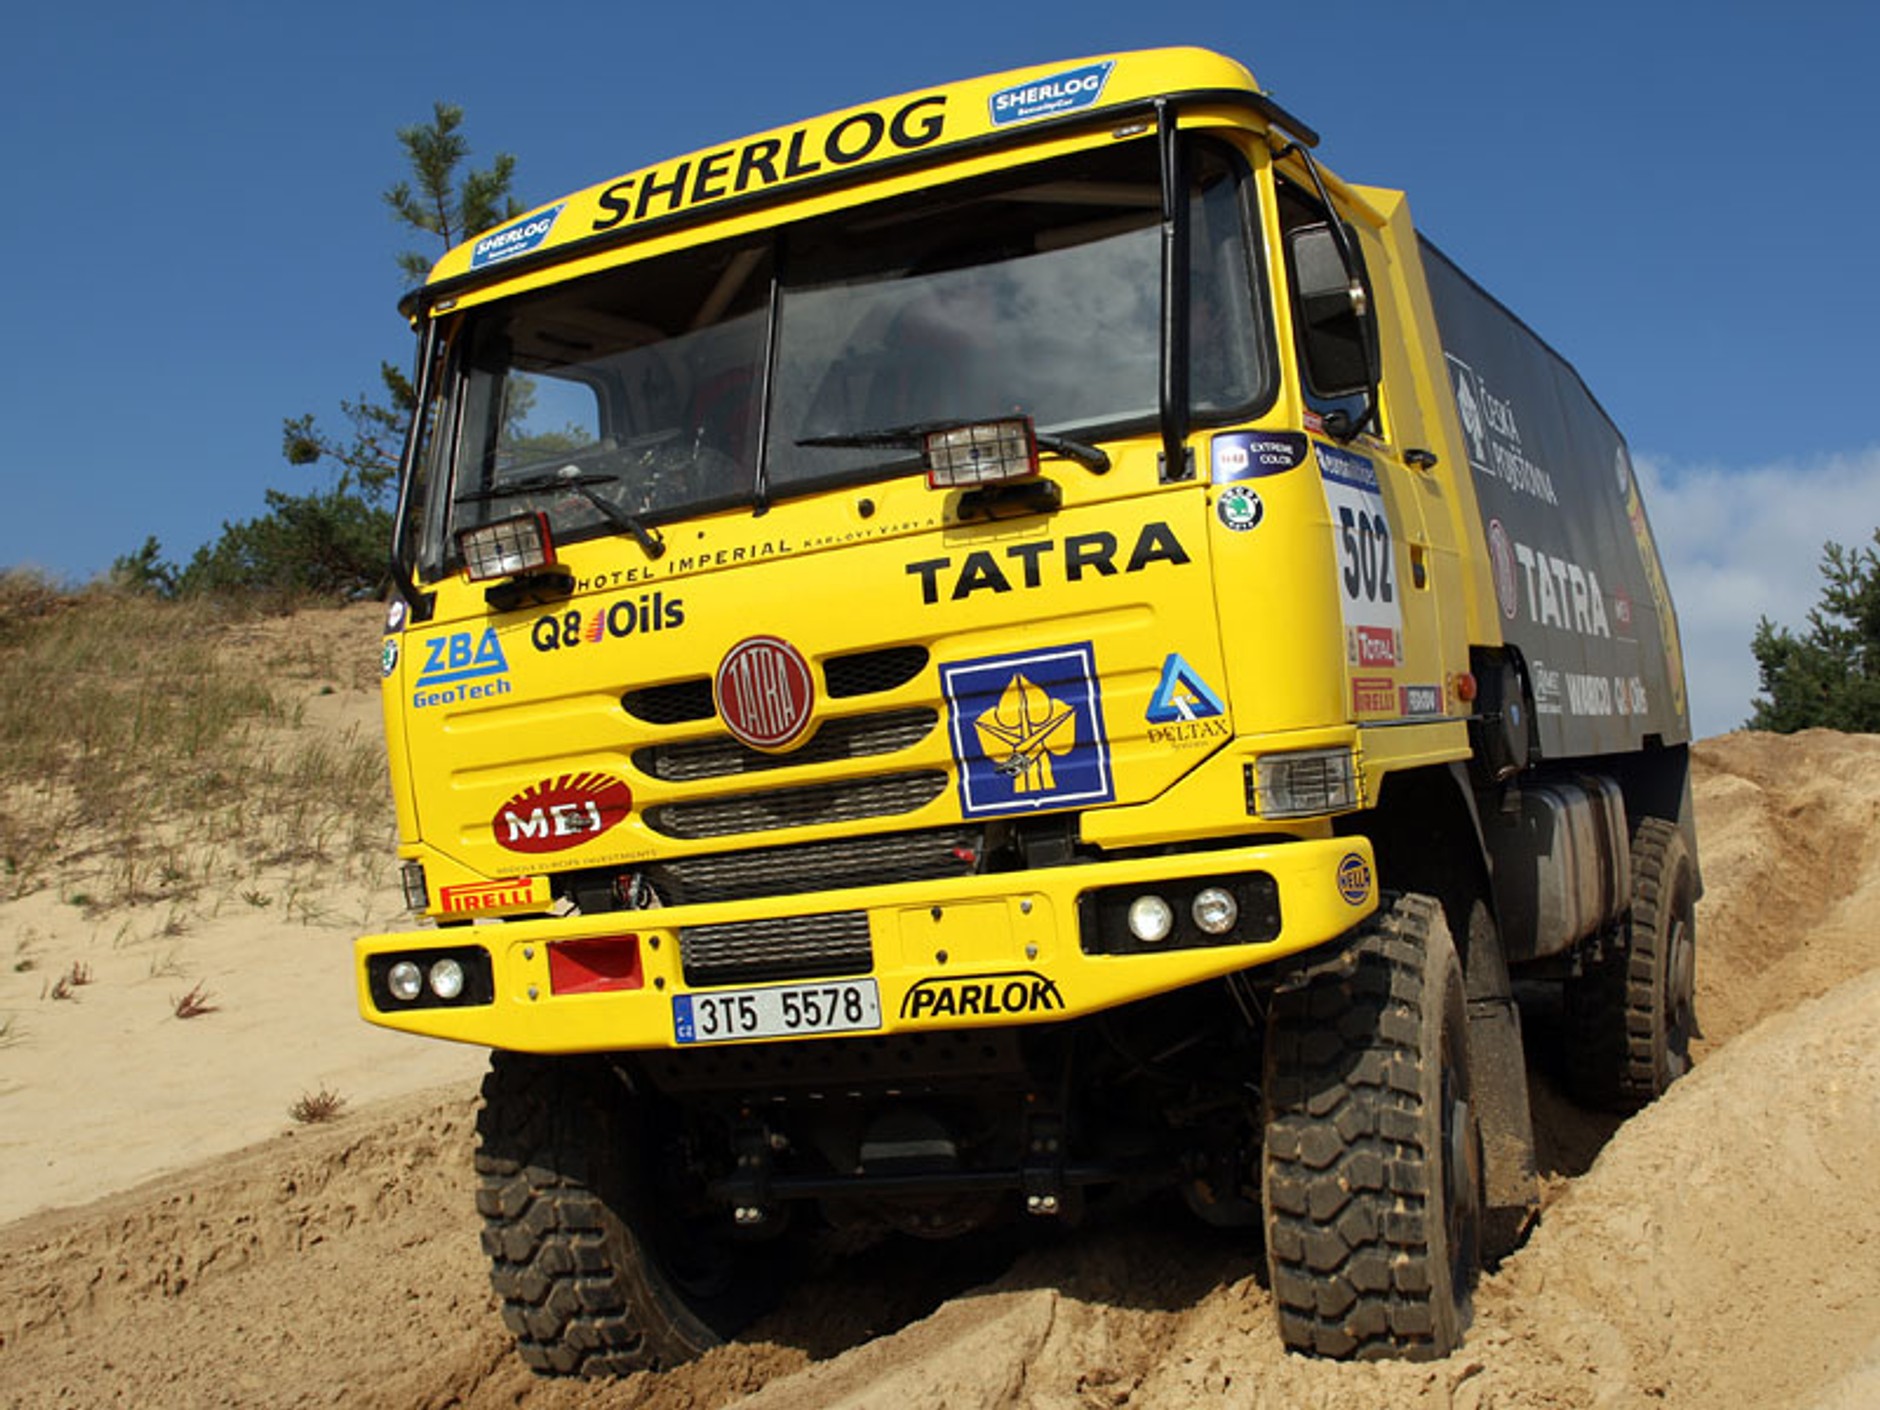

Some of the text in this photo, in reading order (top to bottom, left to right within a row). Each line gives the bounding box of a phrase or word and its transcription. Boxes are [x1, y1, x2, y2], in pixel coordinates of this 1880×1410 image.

[996, 74, 1099, 111] SHERLOG
[592, 95, 948, 232] SHERLOG
[477, 218, 551, 255] SHERLOG
[577, 566, 655, 592] HOTEL
[669, 539, 793, 575] IMPERIAL
[905, 521, 1191, 605] TATRA
[1338, 506, 1392, 603] 502
[1514, 541, 1611, 639] TATRA
[531, 591, 685, 652] Q8 Oils
[421, 627, 509, 676] ZBA
[413, 678, 512, 709] GeoTech
[728, 648, 796, 737] TATRA
[1147, 719, 1229, 743] DELTAX
[441, 877, 532, 913] PIRELLI
[700, 987, 863, 1034] 3T5 5578
[910, 979, 1056, 1019] PARLOK
